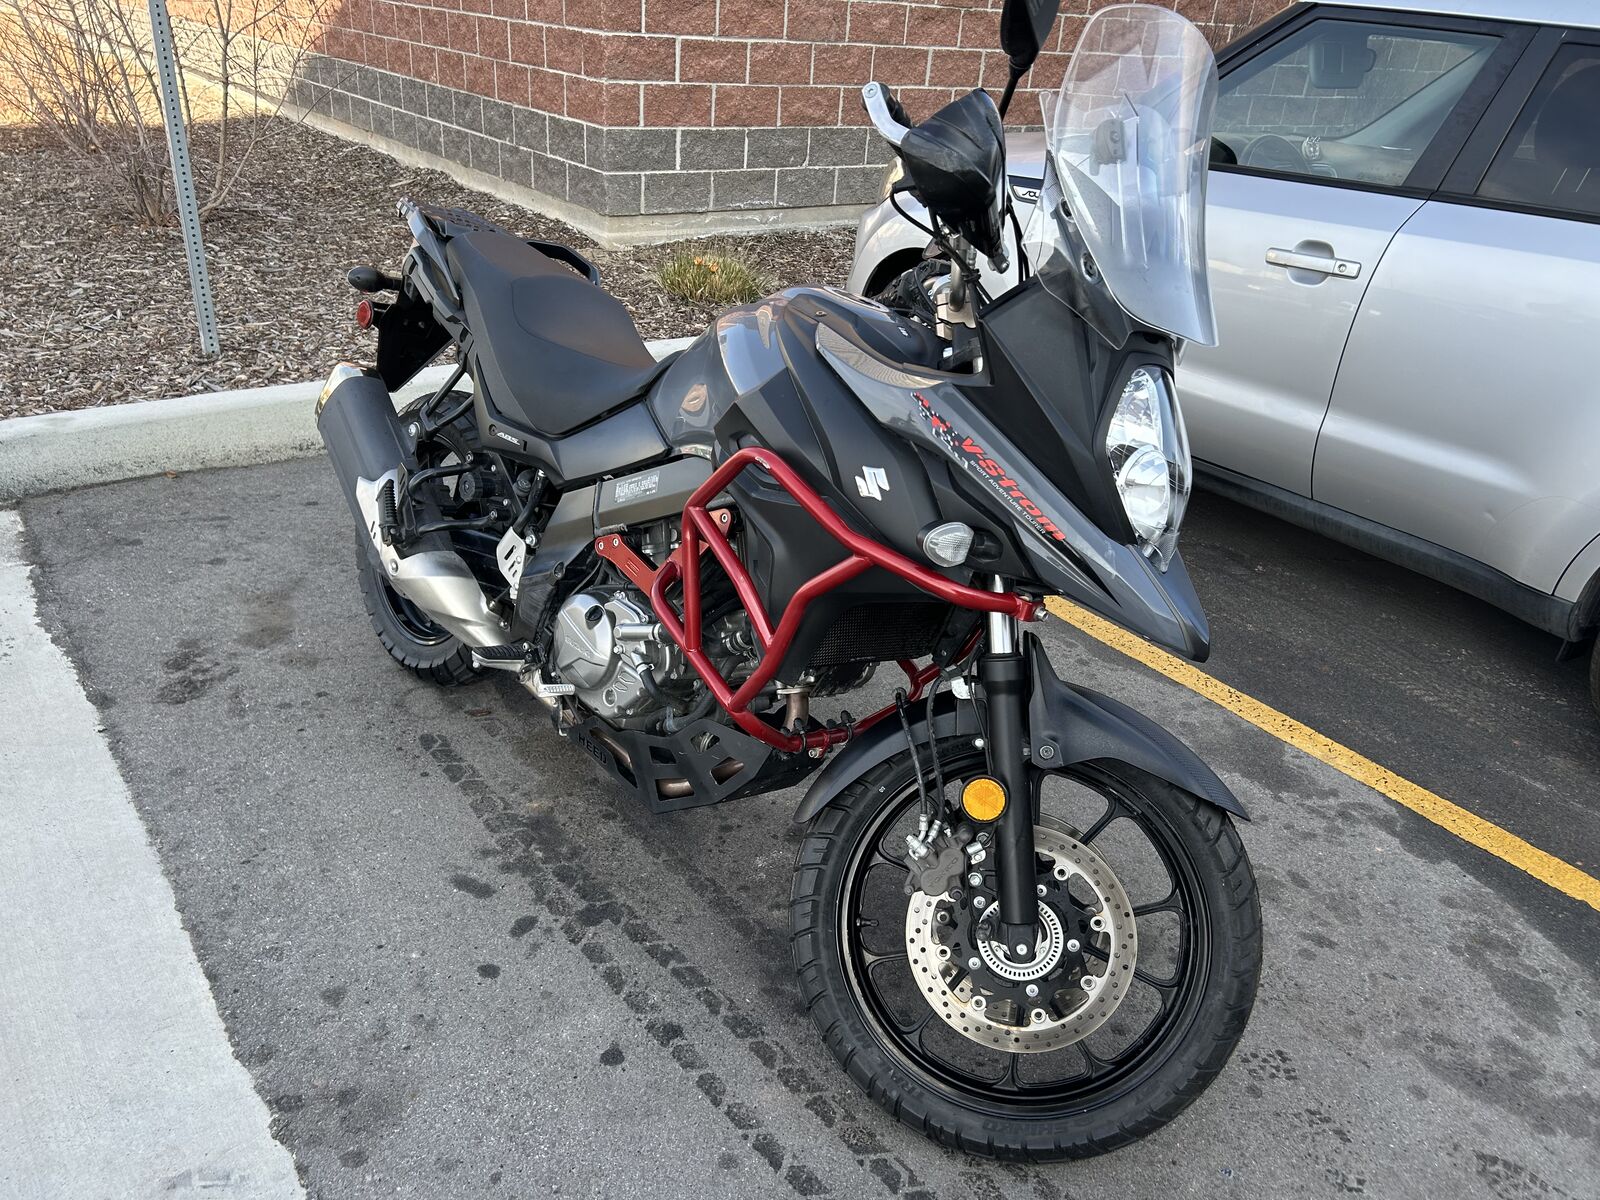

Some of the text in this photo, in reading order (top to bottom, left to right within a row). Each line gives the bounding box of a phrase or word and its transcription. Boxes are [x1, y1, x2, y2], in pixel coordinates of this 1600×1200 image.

[496, 432, 520, 446] ABS
[970, 460, 1046, 534] SPORT ADVENTURE TOURER
[578, 733, 607, 764] HEED
